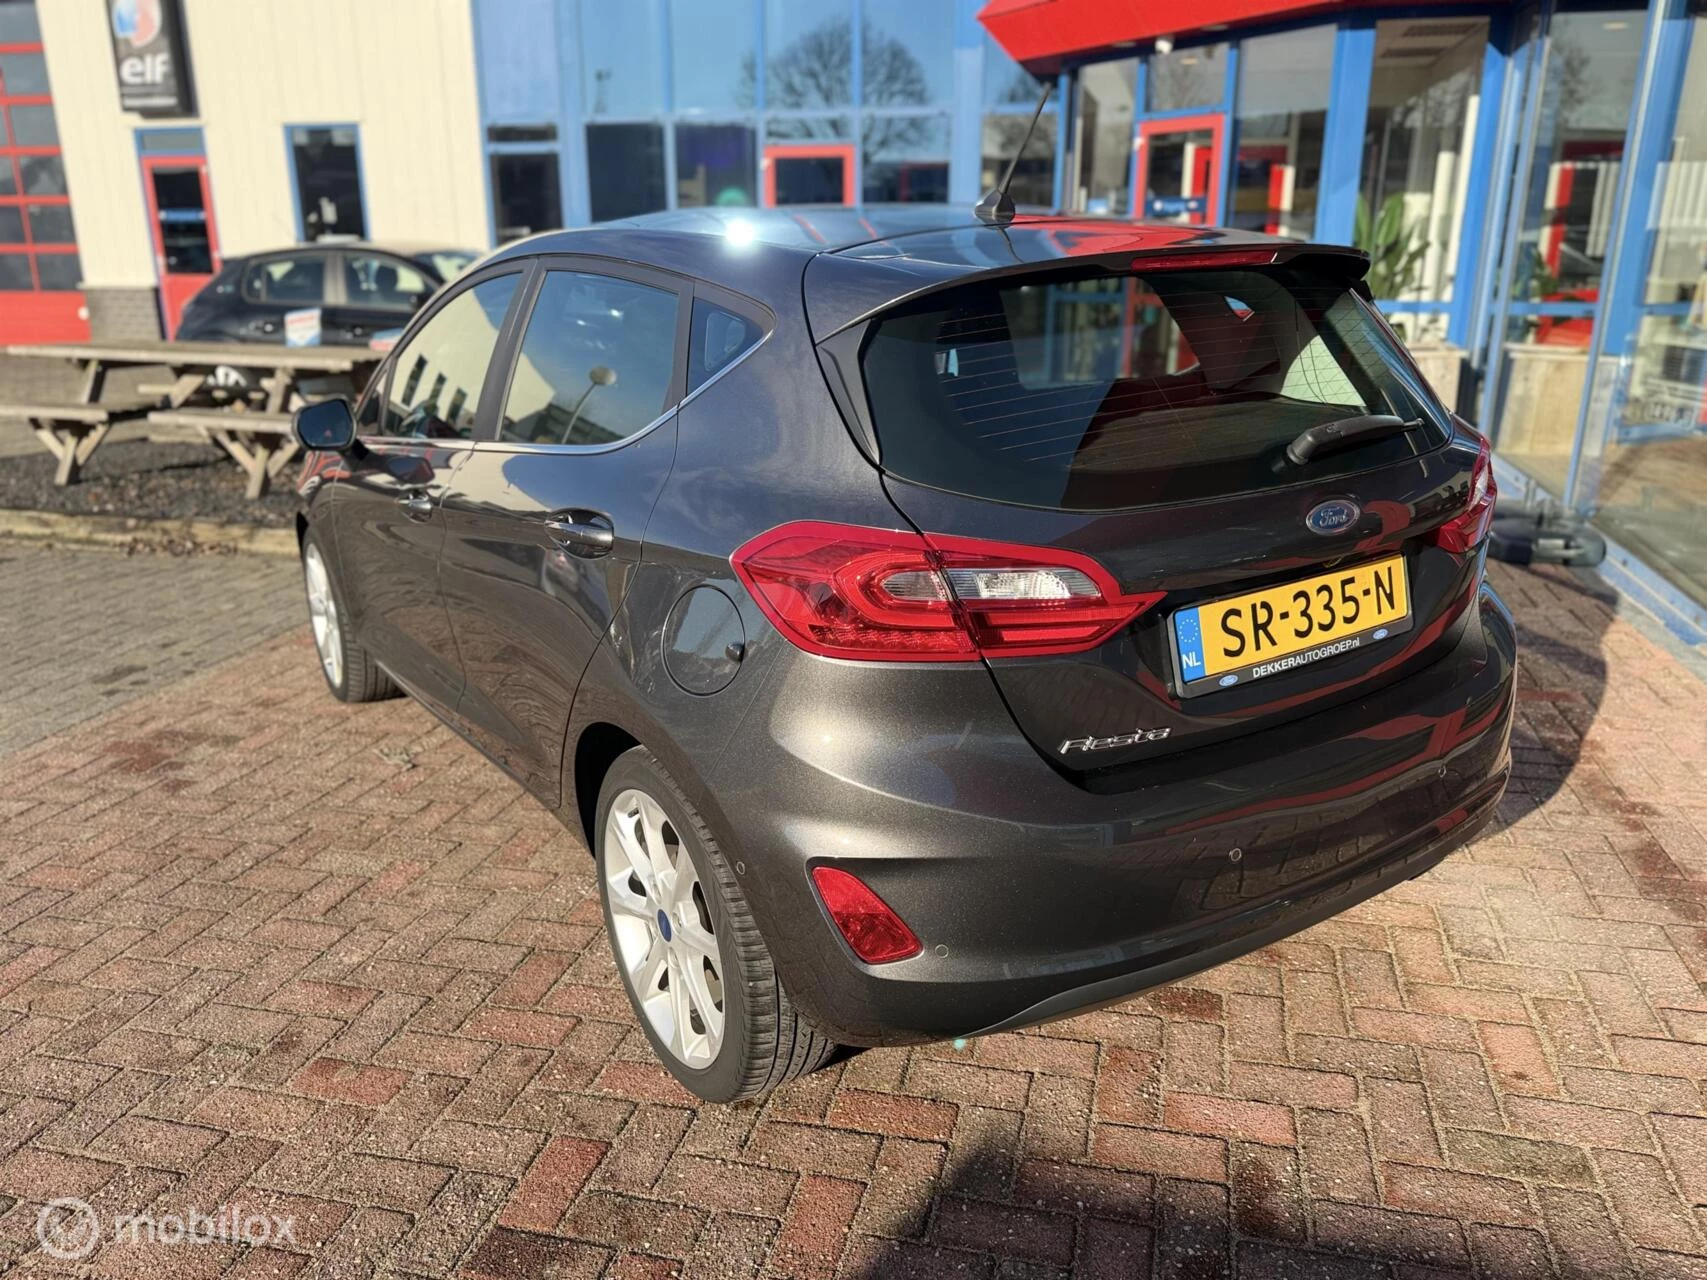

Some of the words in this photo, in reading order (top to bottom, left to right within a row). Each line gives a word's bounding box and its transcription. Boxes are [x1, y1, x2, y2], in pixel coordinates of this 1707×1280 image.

[120, 53, 169, 84] elf
[1319, 506, 1350, 527] Ford
[1220, 565, 1396, 658] SR-335-N
[1182, 650, 1202, 669] NL
[1252, 636, 1361, 679] DEKKERAUTOGROEP.nl
[1058, 728, 1172, 755] Fiesta
